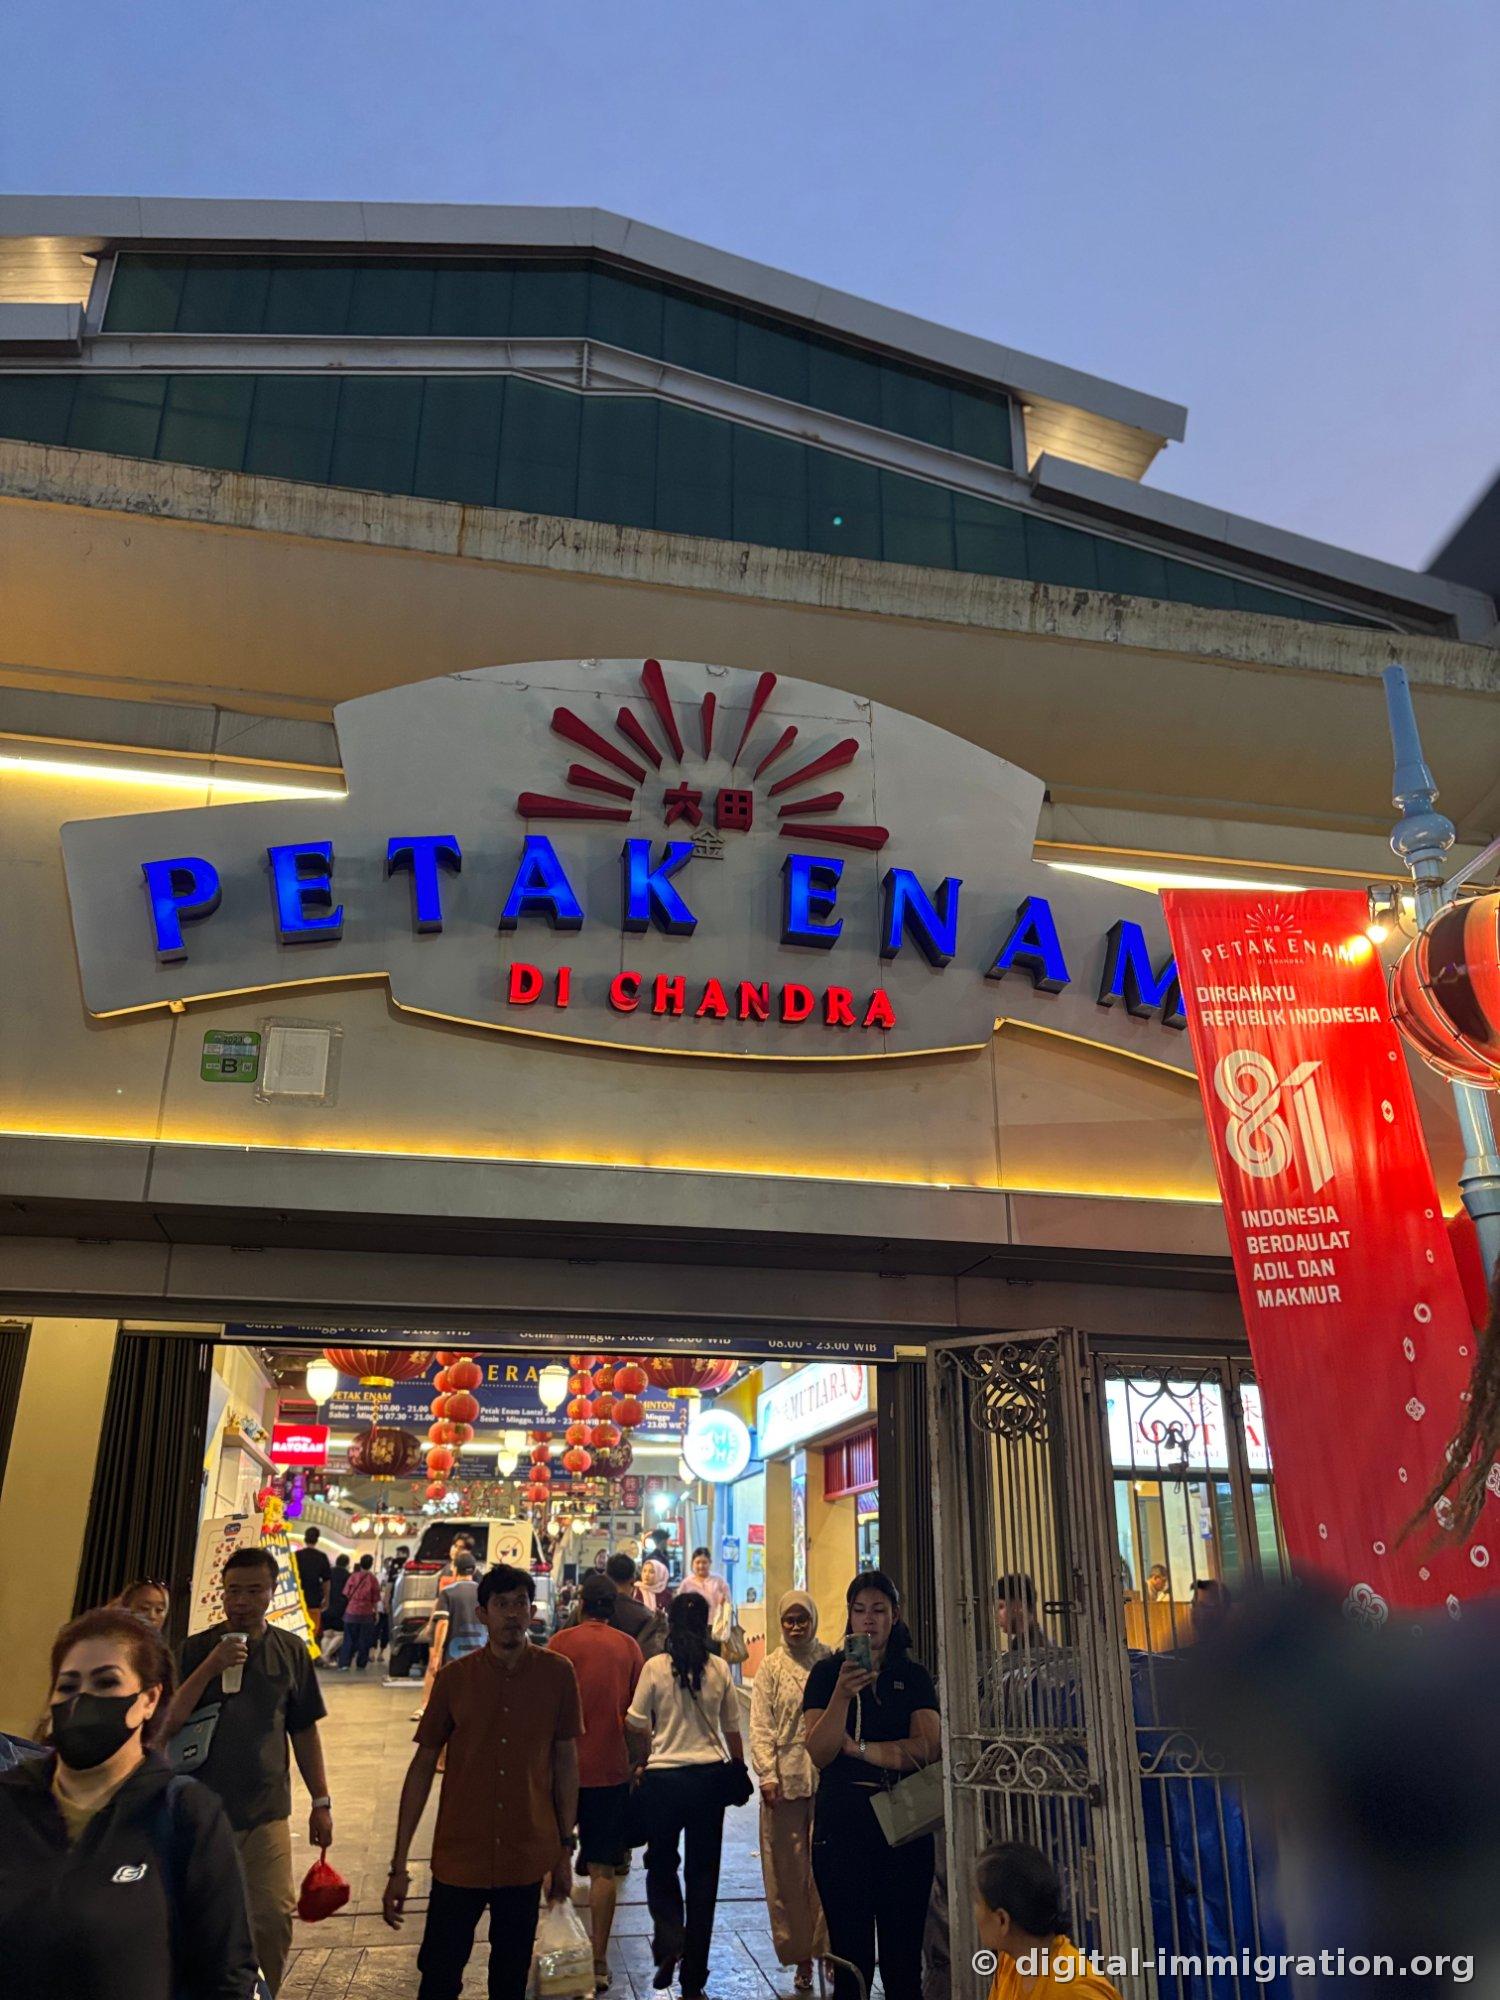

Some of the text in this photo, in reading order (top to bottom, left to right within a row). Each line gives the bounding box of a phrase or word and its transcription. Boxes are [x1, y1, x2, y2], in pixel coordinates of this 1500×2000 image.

[142, 834, 1187, 1030] PETAK ENAM
[1201, 937, 1356, 964] PETAK ENAM
[508, 962, 897, 1030] DI CHANDRA
[1196, 985, 1296, 1003] DIRGAHAYU
[1201, 1006, 1381, 1027] REPUBLIK INDONESIA
[221, 1058, 238, 1073] B
[1213, 1049, 1336, 1194] 81
[1241, 1205, 1340, 1228] INDONESIA
[1246, 1230, 1351, 1255] BERDAULAT
[1253, 1258, 1336, 1281] ADIL DAN
[1256, 1284, 1342, 1309] MAKMUR
[331, 1391, 392, 1401] PETAK ENAM
